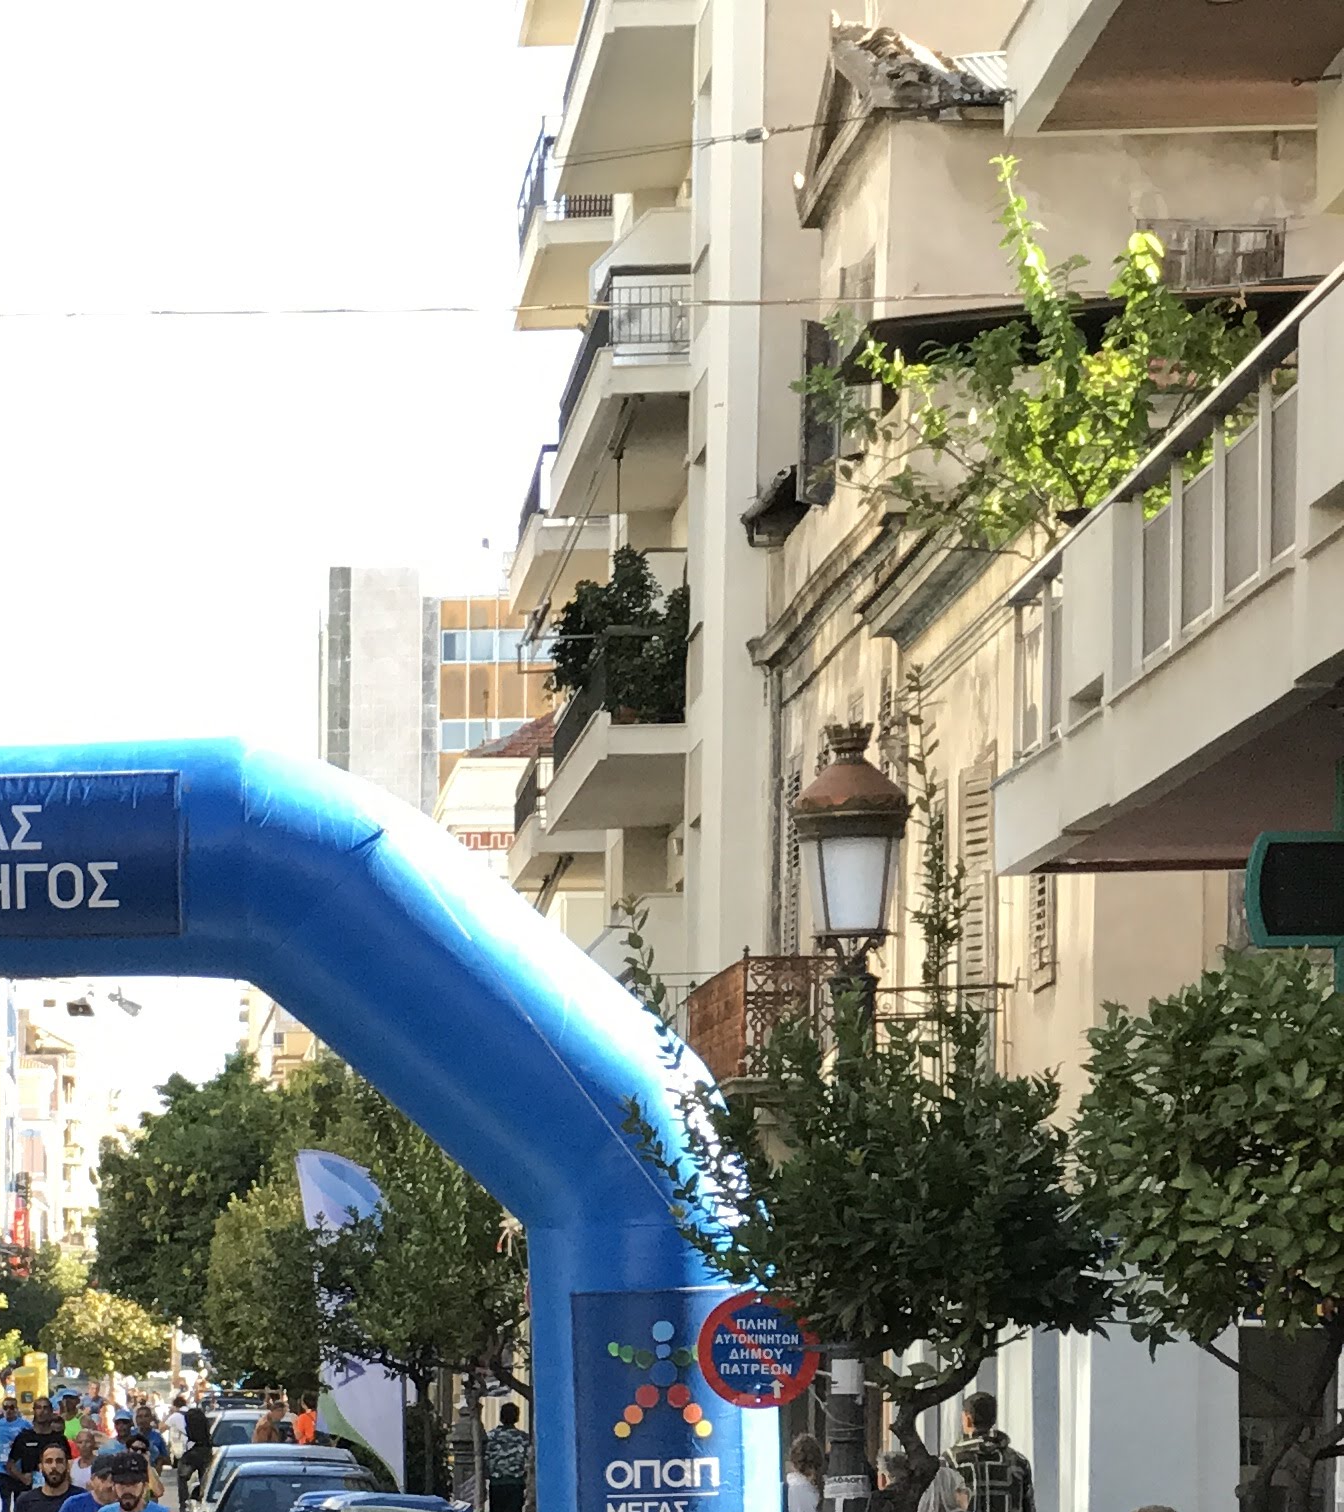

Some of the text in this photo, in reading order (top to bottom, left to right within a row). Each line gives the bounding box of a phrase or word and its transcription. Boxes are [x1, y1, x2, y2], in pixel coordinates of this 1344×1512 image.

[736, 1318, 778, 1330] ΠΛΗΝ
[715, 1333, 799, 1345] ΑΥΤΟΚΙΝΗΤΩΝ
[729, 1348, 784, 1360] ΔΗΜΟΥ
[720, 1363, 793, 1375] ΠΑΤΡΕΩΝ
